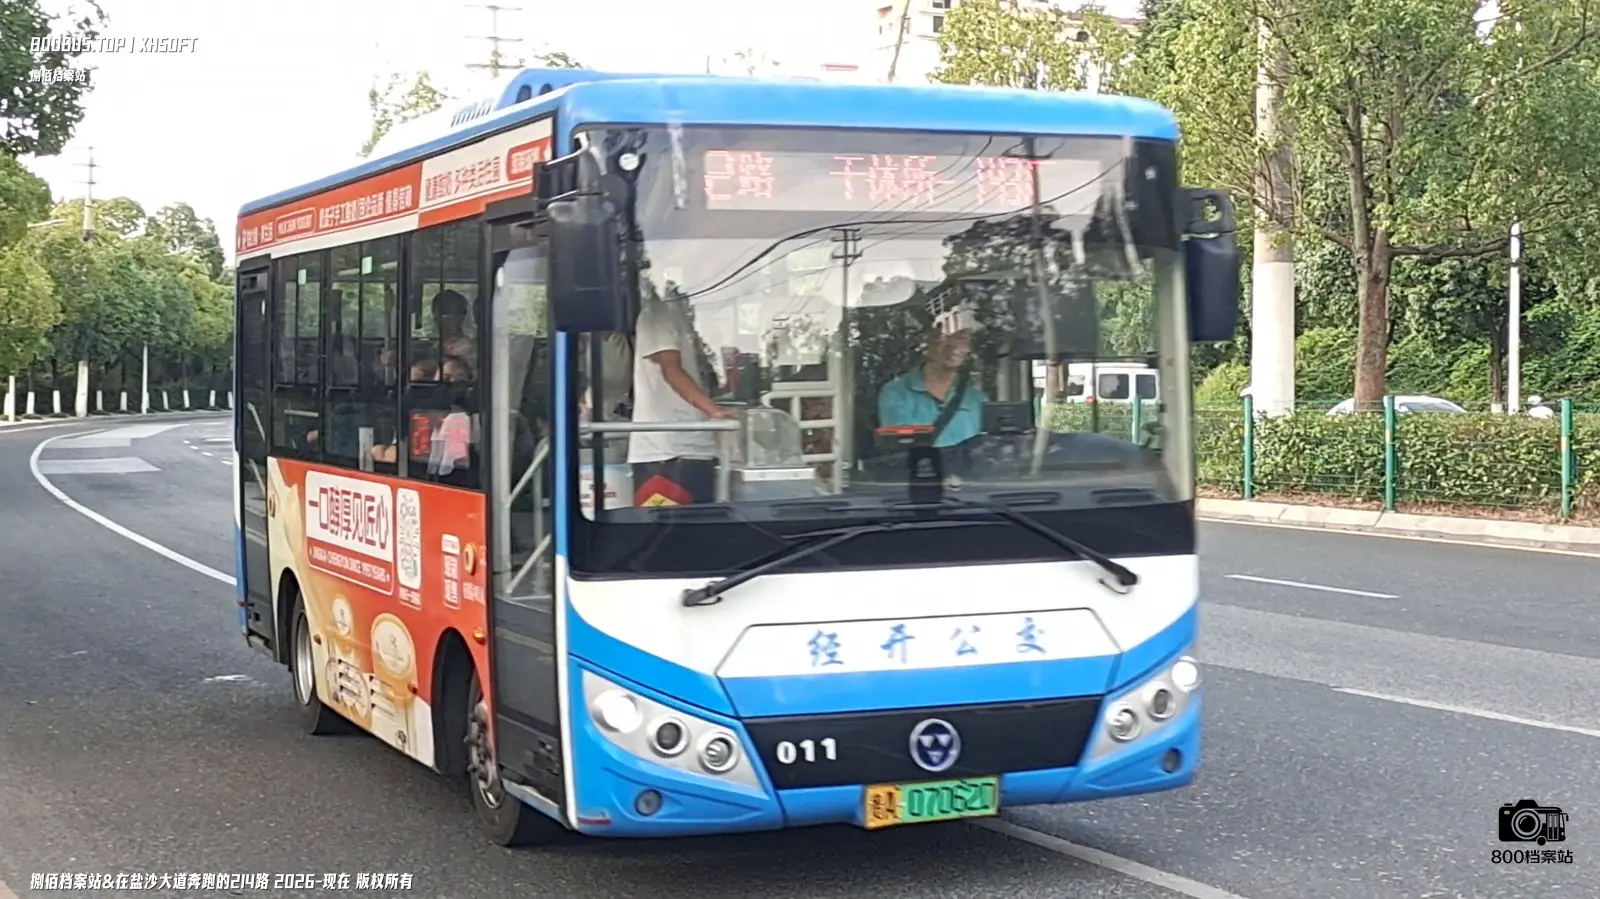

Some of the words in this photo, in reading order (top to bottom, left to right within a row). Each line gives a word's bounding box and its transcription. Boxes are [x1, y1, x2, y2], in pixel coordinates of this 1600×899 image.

[308, 484, 389, 550] 一口醇厚见匠心
[807, 616, 1048, 668] 经开公交
[776, 737, 838, 764] 011
